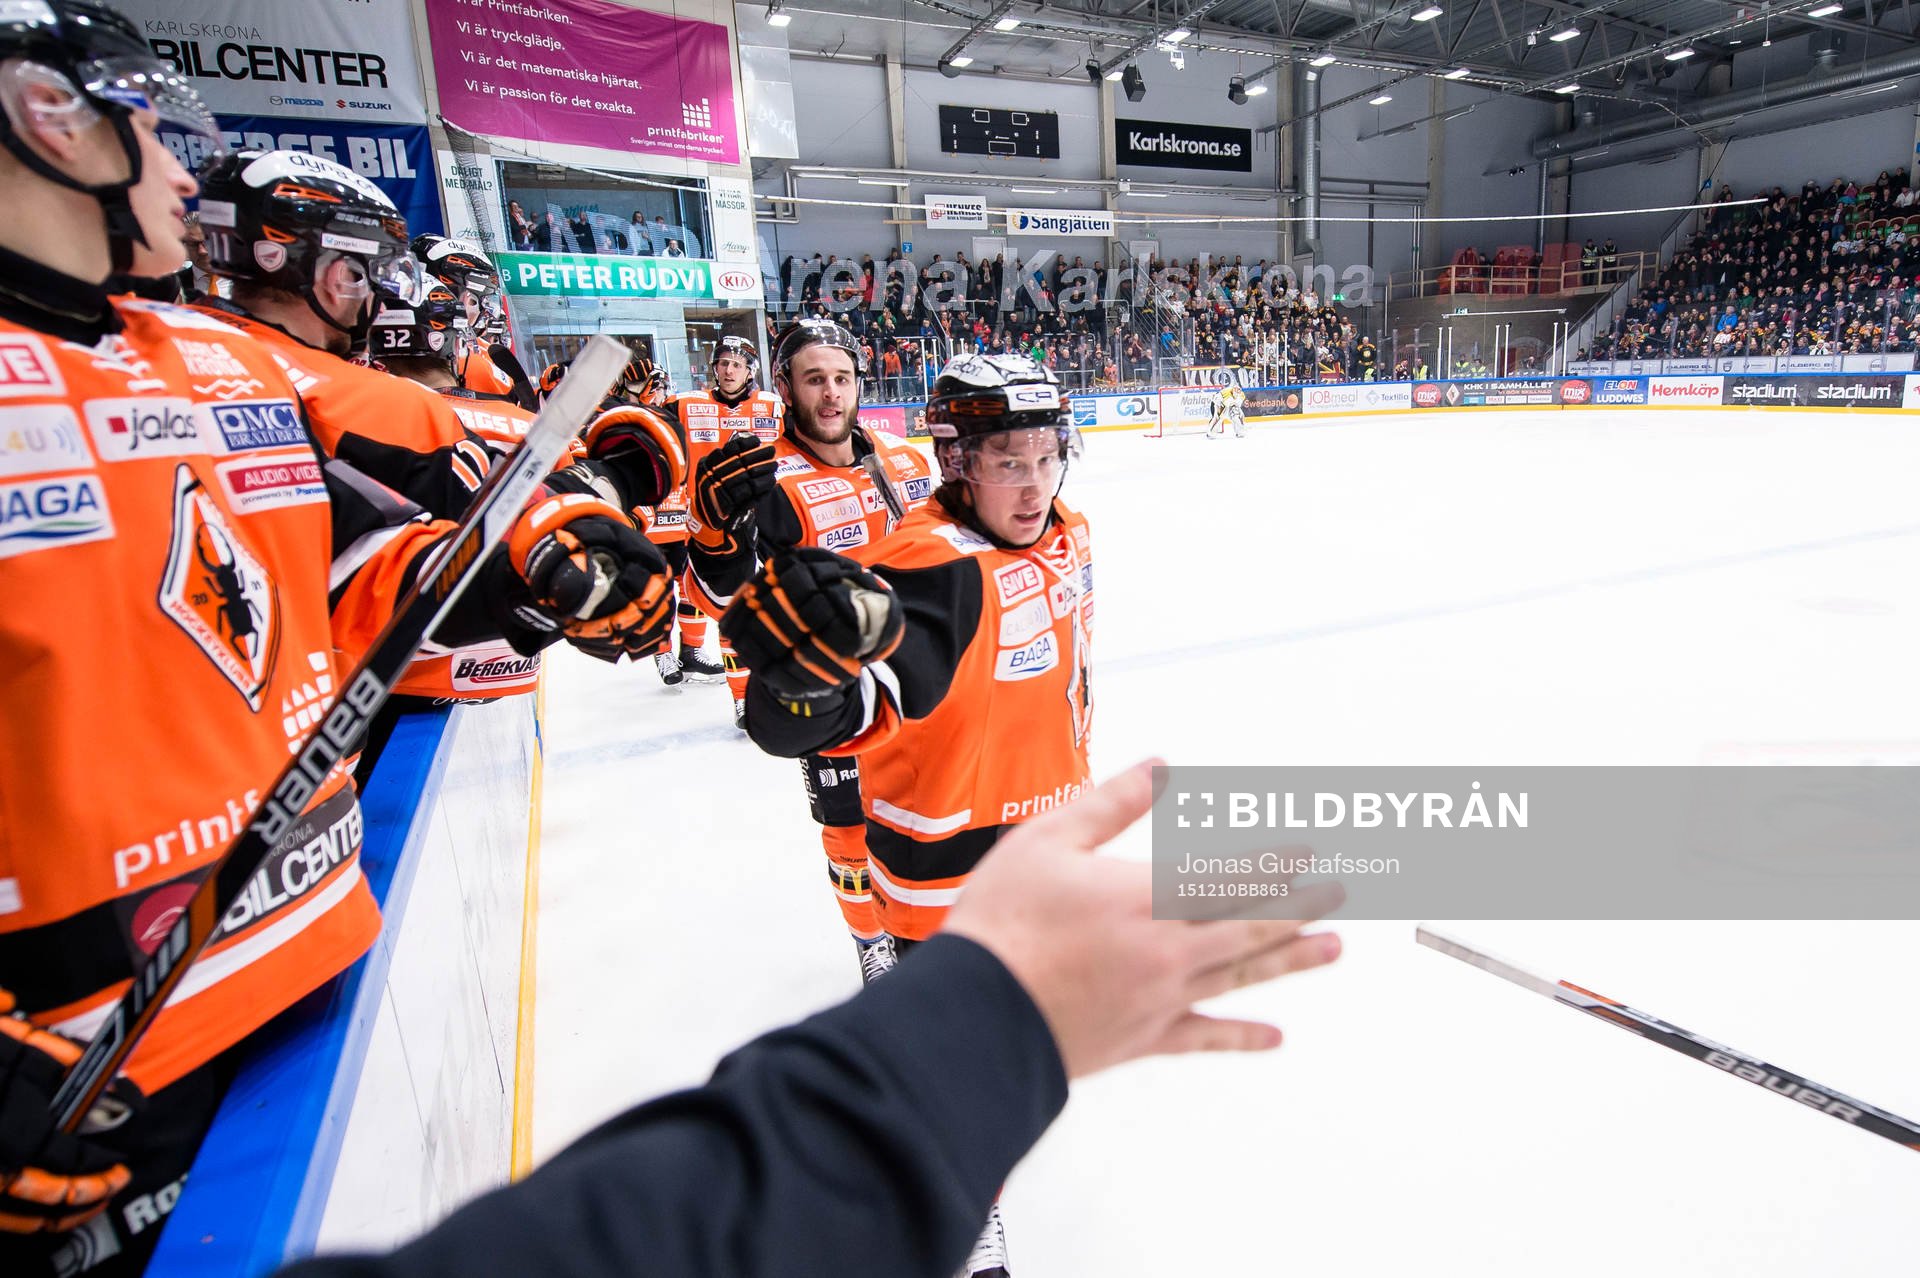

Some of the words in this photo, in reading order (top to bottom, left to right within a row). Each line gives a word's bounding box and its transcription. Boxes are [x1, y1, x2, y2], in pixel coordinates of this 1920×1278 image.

[144, 19, 262, 41] KARLSKRONA
[456, 19, 471, 34] Vi
[474, 23, 487, 37] är
[491, 27, 566, 51] tryckglädje.
[149, 38, 389, 89] BILCENTER
[460, 49, 475, 63] Vi
[478, 53, 491, 66] är
[496, 56, 517, 70] det
[521, 61, 598, 83] matematiska
[601, 71, 643, 90] hjärtat.
[284, 97, 324, 107] mazda
[348, 101, 392, 111] SUZUKI
[464, 79, 479, 92] Vi
[482, 82, 495, 95] är
[500, 85, 547, 102] passion
[550, 91, 568, 105] för
[571, 95, 592, 109] det
[594, 98, 636, 115] exakta.
[647, 126, 724, 144] printfabriken
[1129, 131, 1241, 156] Karlskrona.se
[347, 136, 417, 179] BIL
[519, 263, 616, 290] PETER
[618, 266, 706, 291] RUDVI
[725, 275, 749, 287] KIA
[999, 247, 1375, 312] Karlskrona
[383, 329, 411, 348] 32
[1604, 380, 1638, 391] ELON
[1652, 383, 1720, 398] Hemköp
[1732, 383, 1797, 398] stadium
[1816, 383, 1892, 399] stadium
[772, 401, 782, 418] A
[1244, 397, 1285, 408] Swedbank
[128, 406, 198, 451] jalas
[694, 430, 716, 439] BAGA
[245, 469, 289, 488] AUDIO
[806, 480, 847, 498] SAVE
[0, 482, 98, 524] AGA
[826, 524, 863, 546] BAGA
[1009, 637, 1051, 668] BAGA
